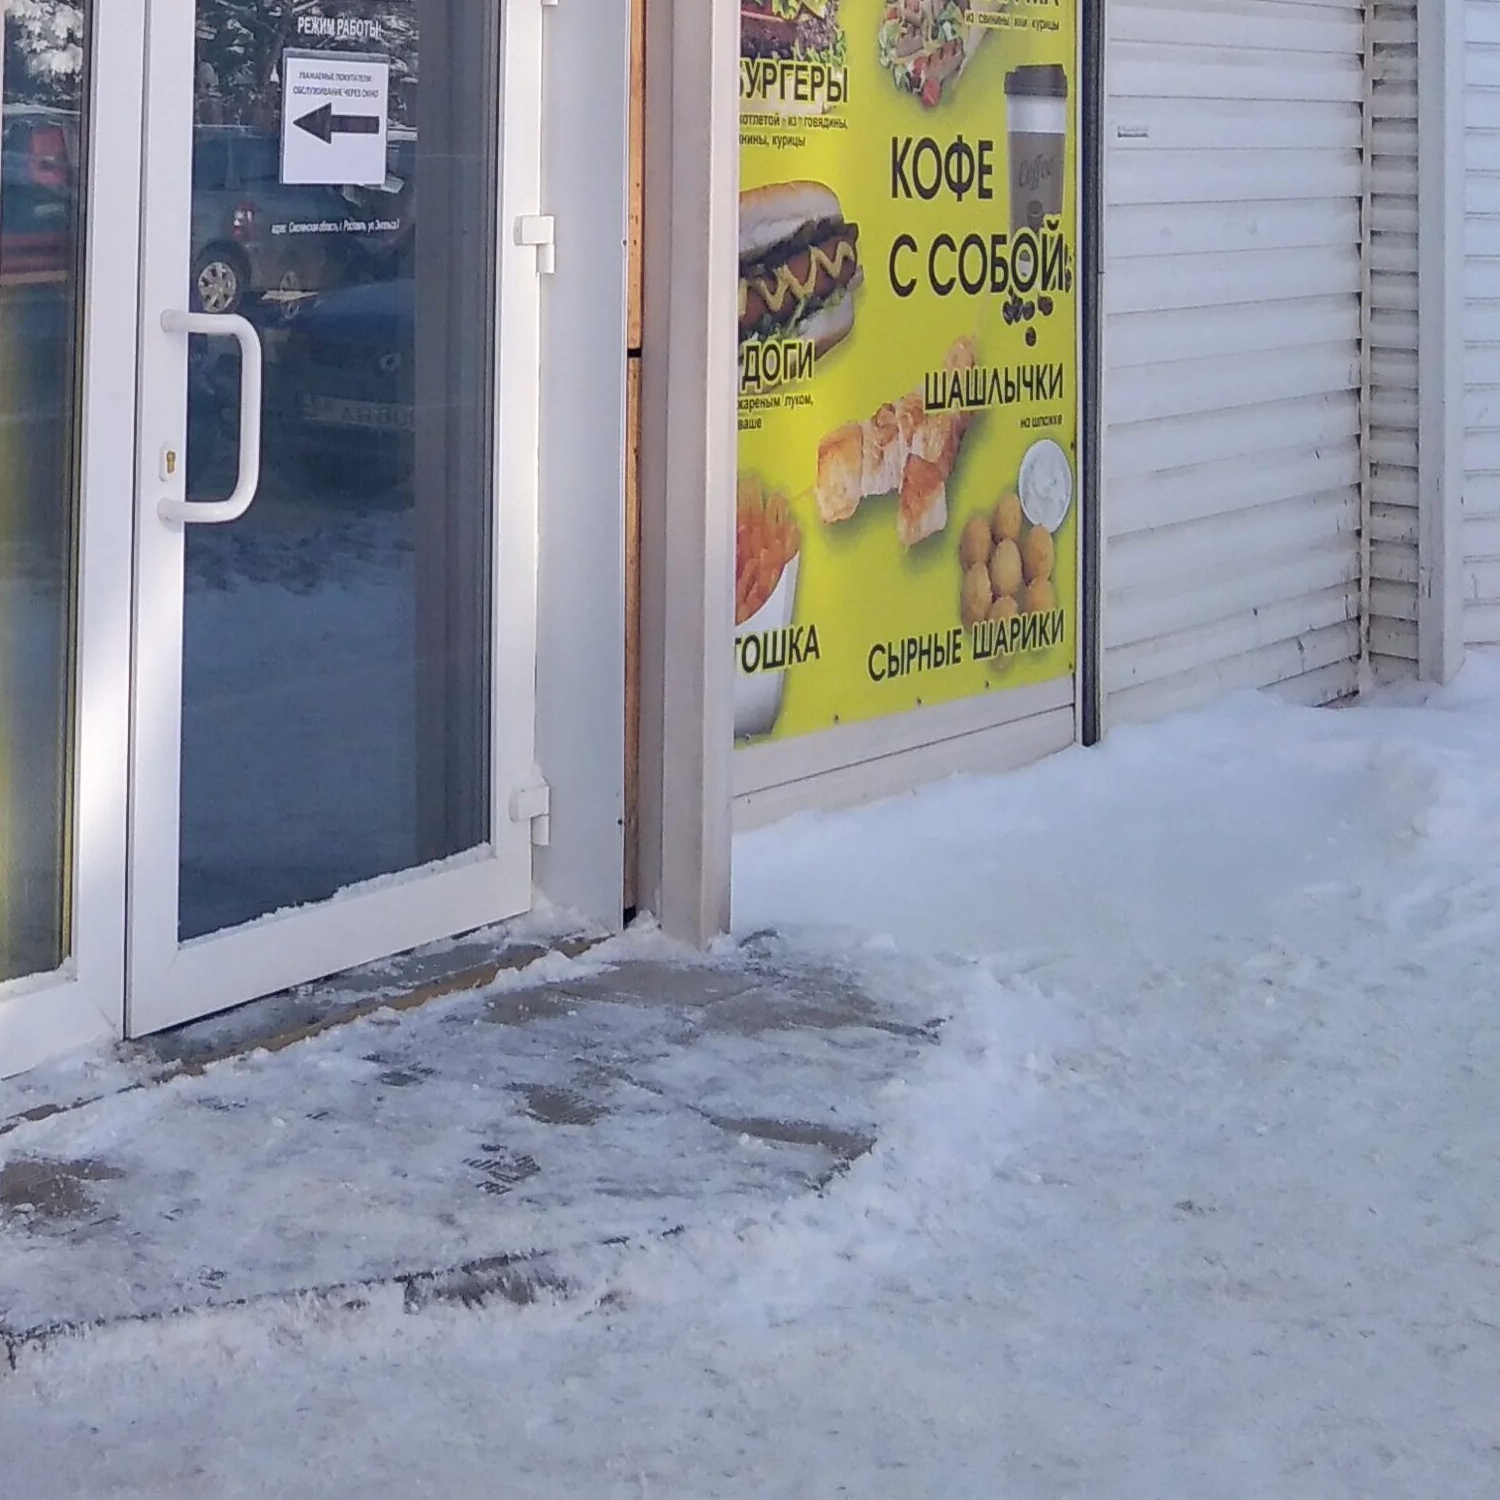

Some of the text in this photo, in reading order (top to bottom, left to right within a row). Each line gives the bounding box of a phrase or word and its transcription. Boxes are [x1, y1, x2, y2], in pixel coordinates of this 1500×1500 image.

[297, 17, 335, 35] РЕЖИМ
[891, 135, 993, 201] КОФЕ
[890, 218, 1064, 298] С СОБОЙ
[742, 342, 812, 391] ДОГИ
[925, 362, 1064, 410] ШАШЛЫЧКИ
[868, 610, 1065, 681] СЫРНЫЕ ШАРИКИ
